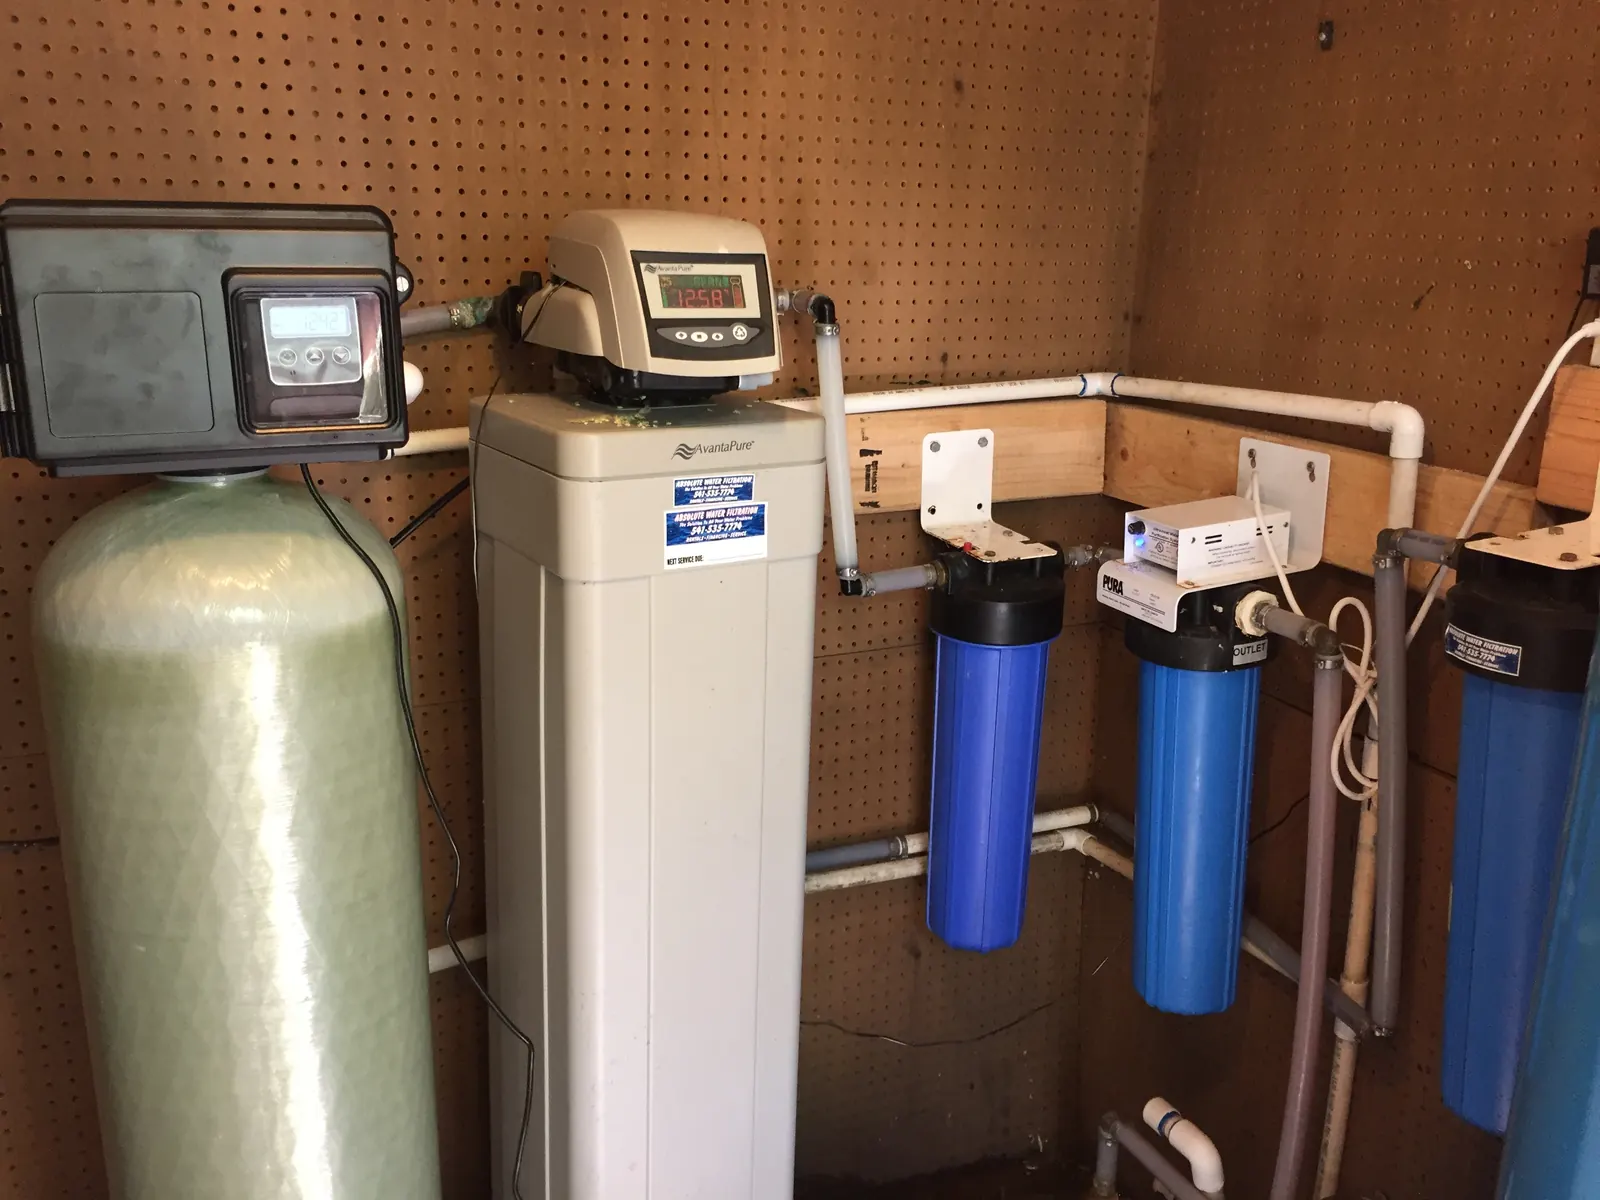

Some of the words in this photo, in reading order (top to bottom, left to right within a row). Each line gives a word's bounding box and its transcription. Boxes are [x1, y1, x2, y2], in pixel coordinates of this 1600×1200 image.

[695, 440, 754, 454] AvantaPure
[675, 479, 703, 488] ABSOLUTE
[704, 477, 722, 486] WATER
[722, 475, 753, 485] FILTRATION
[693, 488, 735, 499] 541-535-7774
[674, 512, 705, 522] ABSOLUTE
[705, 508, 725, 519] WATER
[726, 506, 759, 517] FILTRATION
[690, 521, 743, 535] 541-535-7774
[667, 557, 677, 565] NEXT
[677, 555, 694, 564] SERVICE
[1102, 574, 1123, 596] PURA
[1233, 643, 1265, 656] OUTLET
[1465, 636, 1483, 647] WATER
[1483, 641, 1518, 655] FILTRATION
